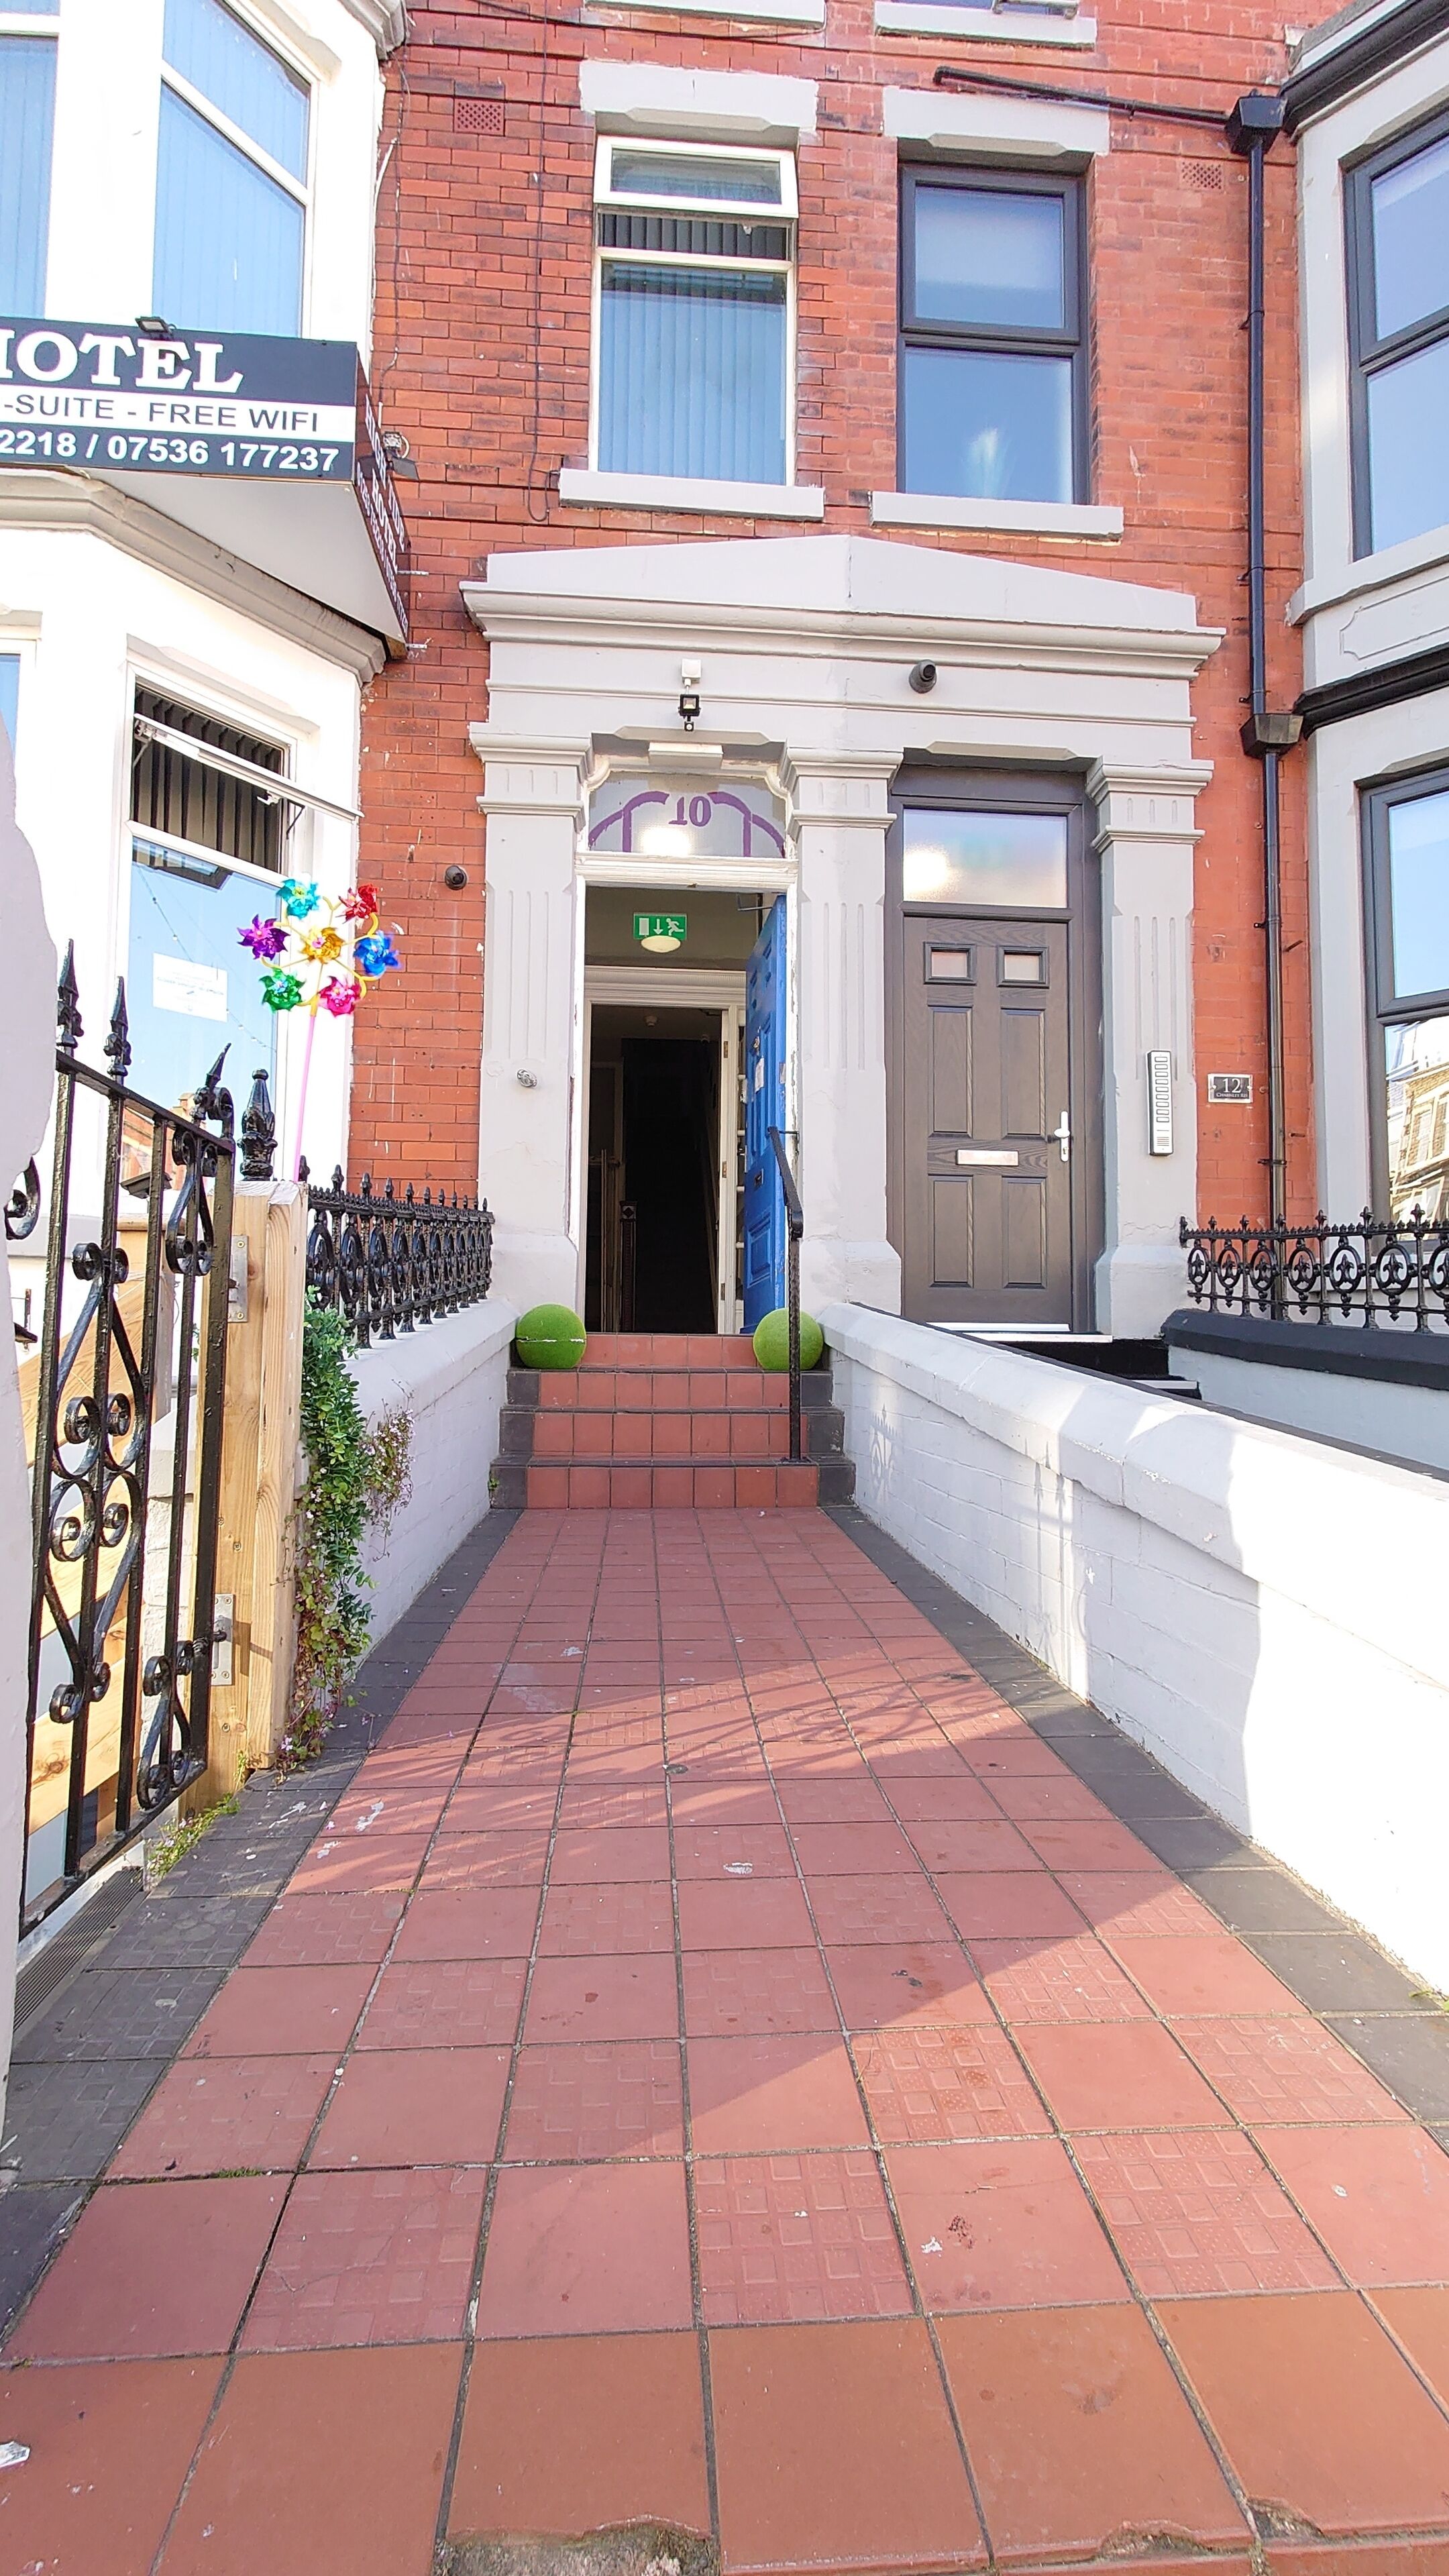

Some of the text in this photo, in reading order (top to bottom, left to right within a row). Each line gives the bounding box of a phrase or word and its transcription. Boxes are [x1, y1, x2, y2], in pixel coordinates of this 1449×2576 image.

[0, 329, 244, 393] OTEL
[149, 402, 237, 427] FREE
[249, 408, 318, 432] WIFI
[85, 433, 99, 459] /
[107, 435, 210, 464] 07536
[221, 441, 339, 472] 177237
[668, 796, 712, 826] 10
[1222, 1077, 1242, 1093] 12
